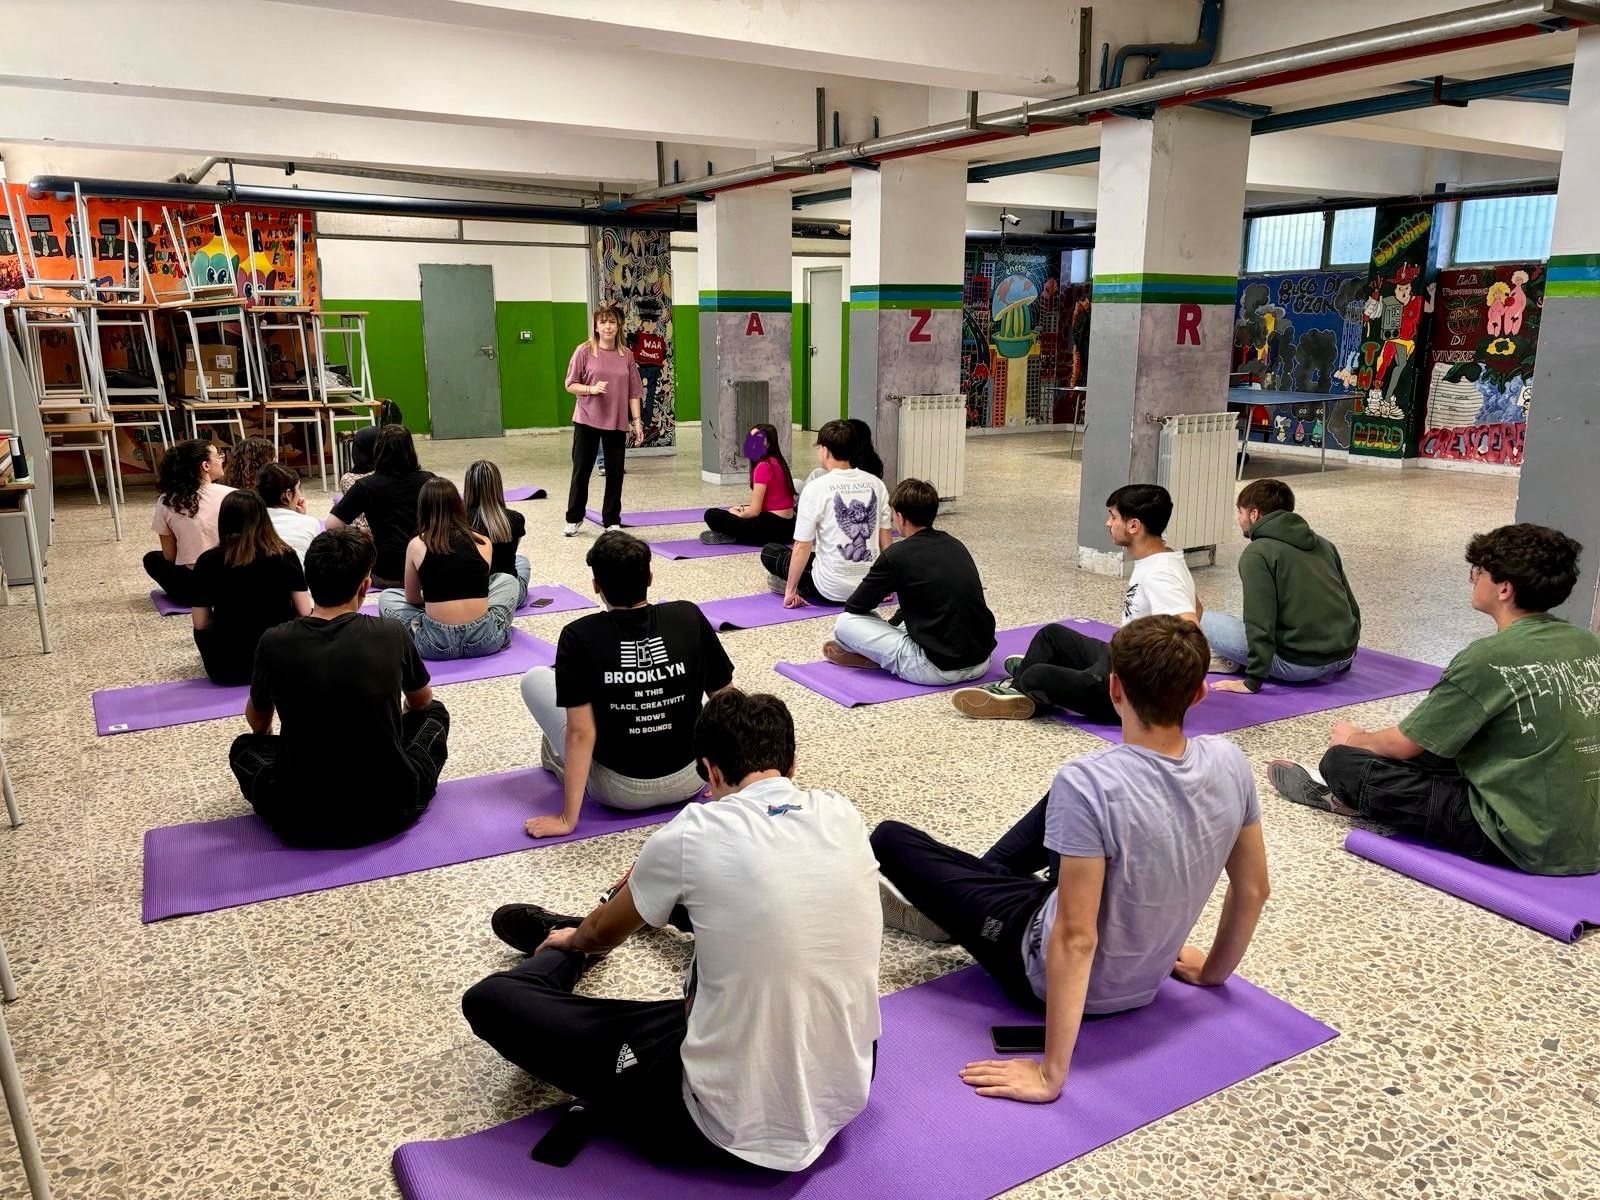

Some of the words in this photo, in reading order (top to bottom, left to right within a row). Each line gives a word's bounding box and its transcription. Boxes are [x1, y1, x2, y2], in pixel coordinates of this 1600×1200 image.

[745, 312, 765, 336] A
[908, 308, 932, 343] Z
[1177, 303, 1202, 346] R
[643, 339, 662, 350] WAR
[1450, 335, 1467, 346] DI
[1432, 350, 1477, 363] VIVERE
[604, 662, 686, 684] BROOKLYN
[634, 690, 643, 698] IN
[645, 687, 664, 697] THIS
[640, 694, 686, 710] CREATIVITY
[635, 712, 666, 722] KNOWS
[629, 727, 641, 735] NO
[642, 723, 673, 734] BOUNDS
[615, 1043, 629, 1074] adidas
